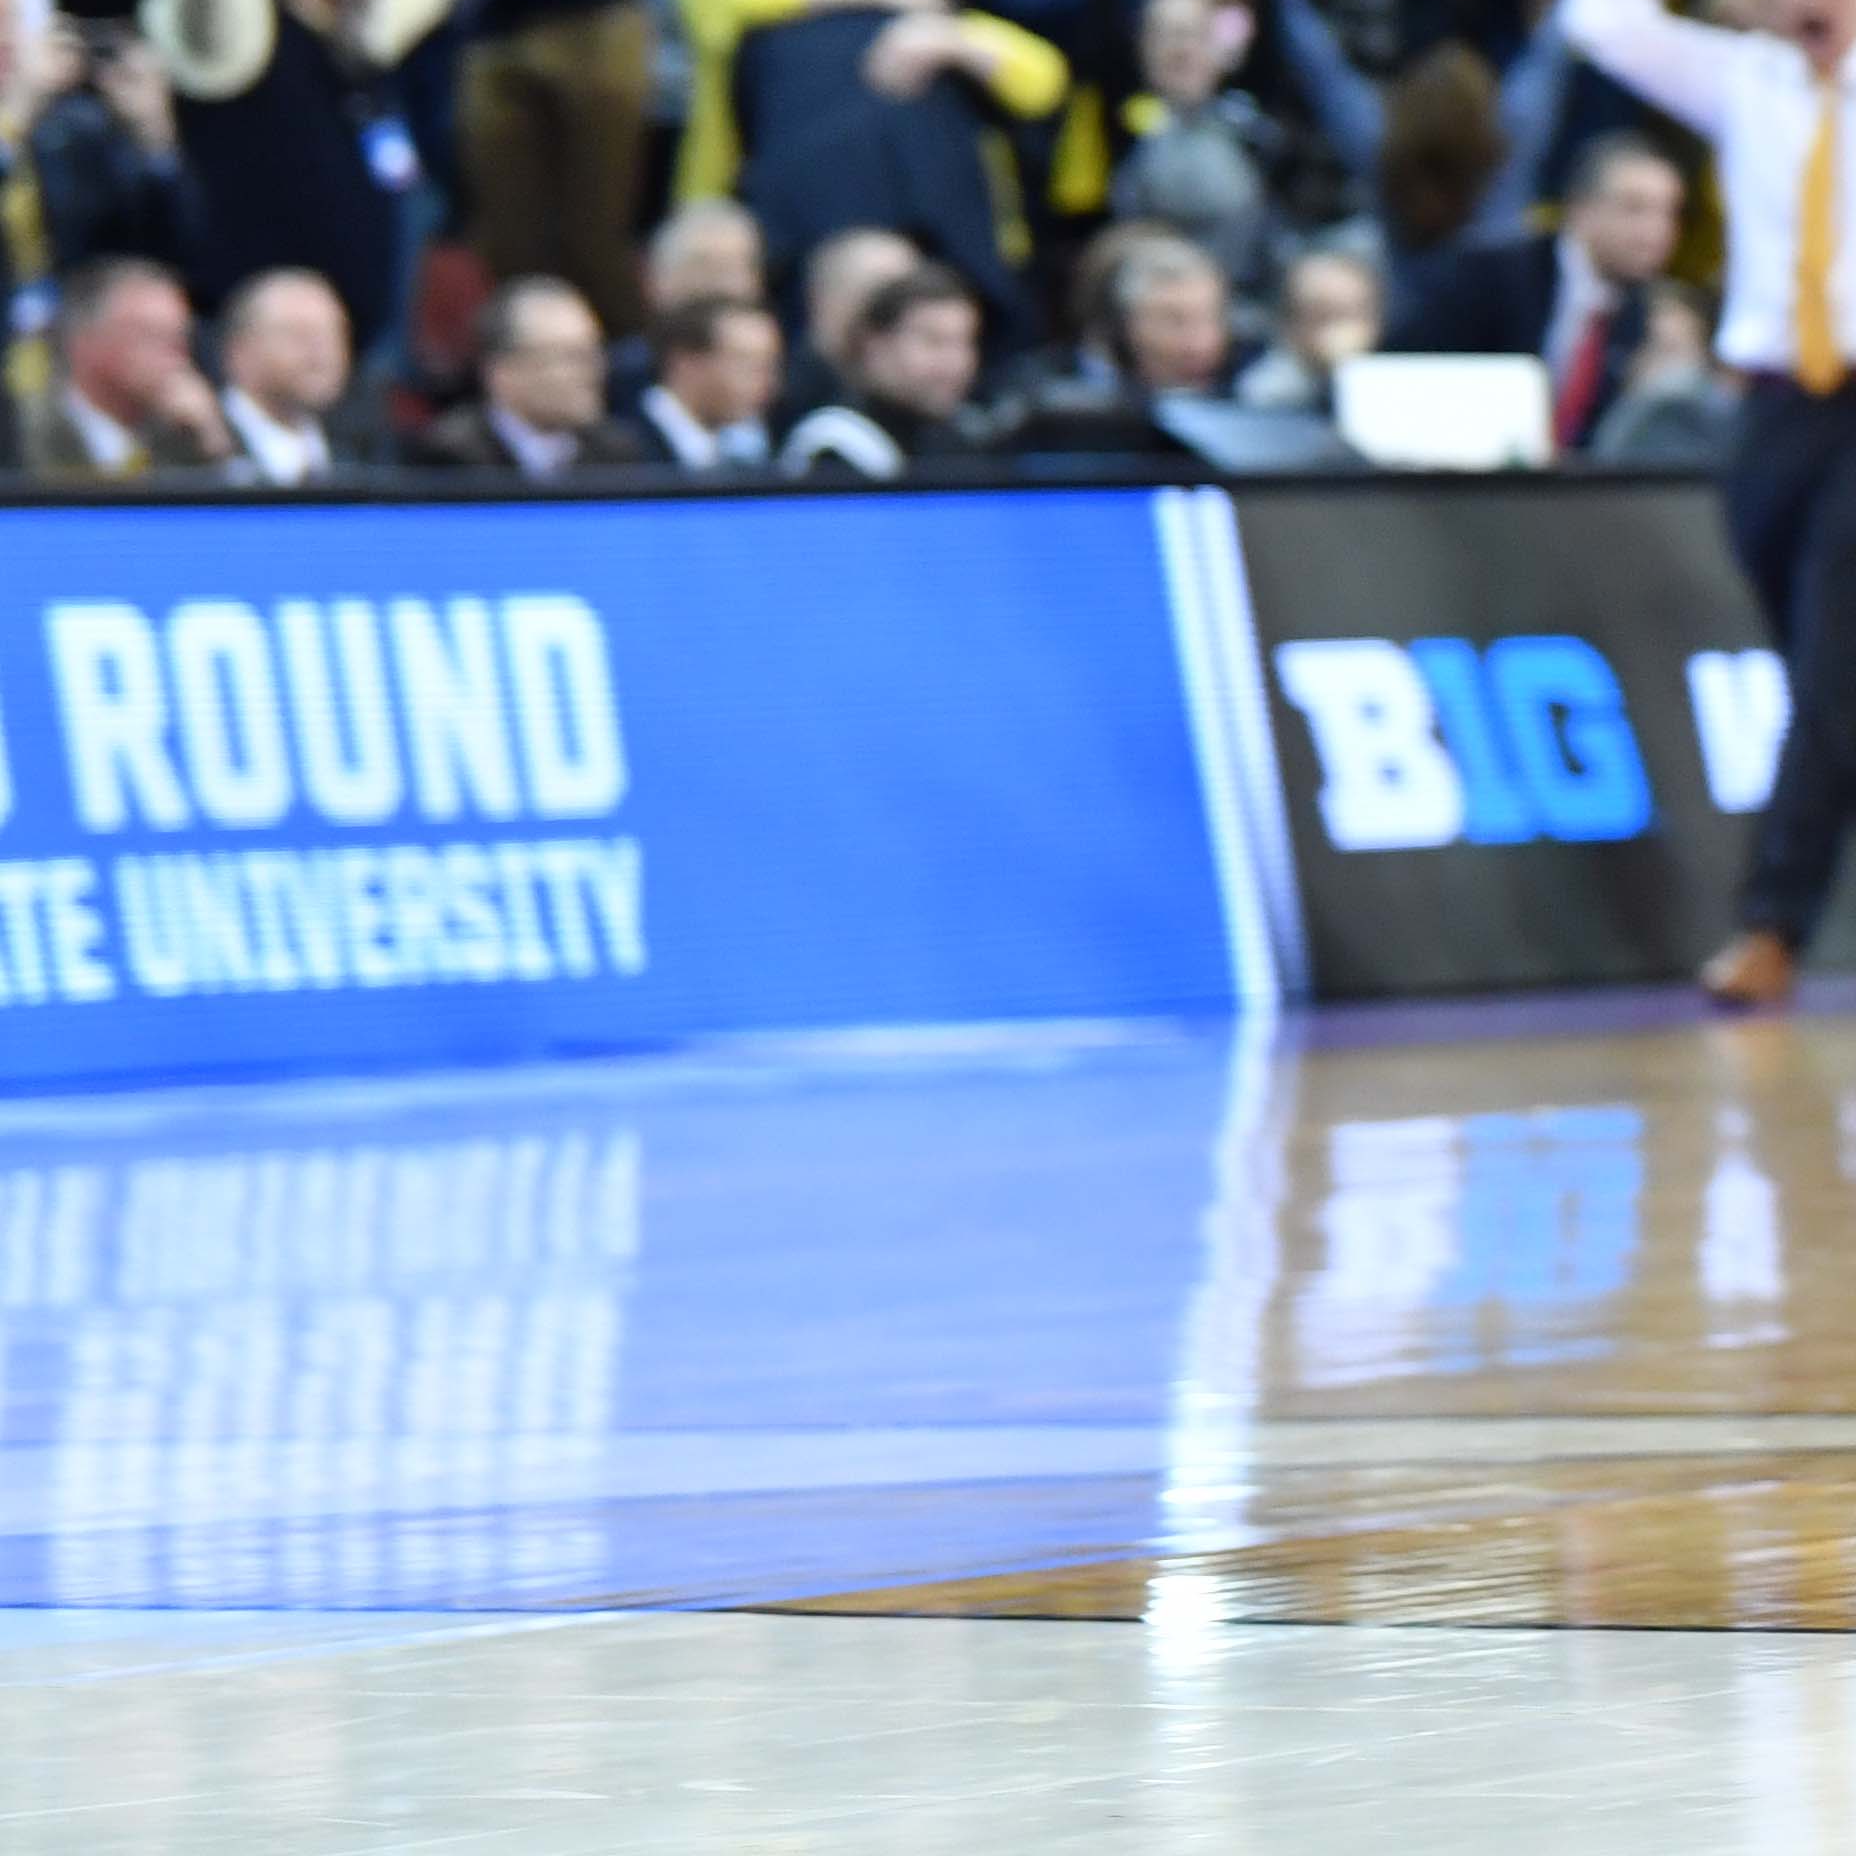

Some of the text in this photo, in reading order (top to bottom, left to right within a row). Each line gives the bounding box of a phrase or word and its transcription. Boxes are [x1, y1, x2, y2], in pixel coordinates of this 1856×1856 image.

[46, 592, 630, 832] ROUND
[0, 835, 648, 1006] TE UNIVERSITY
